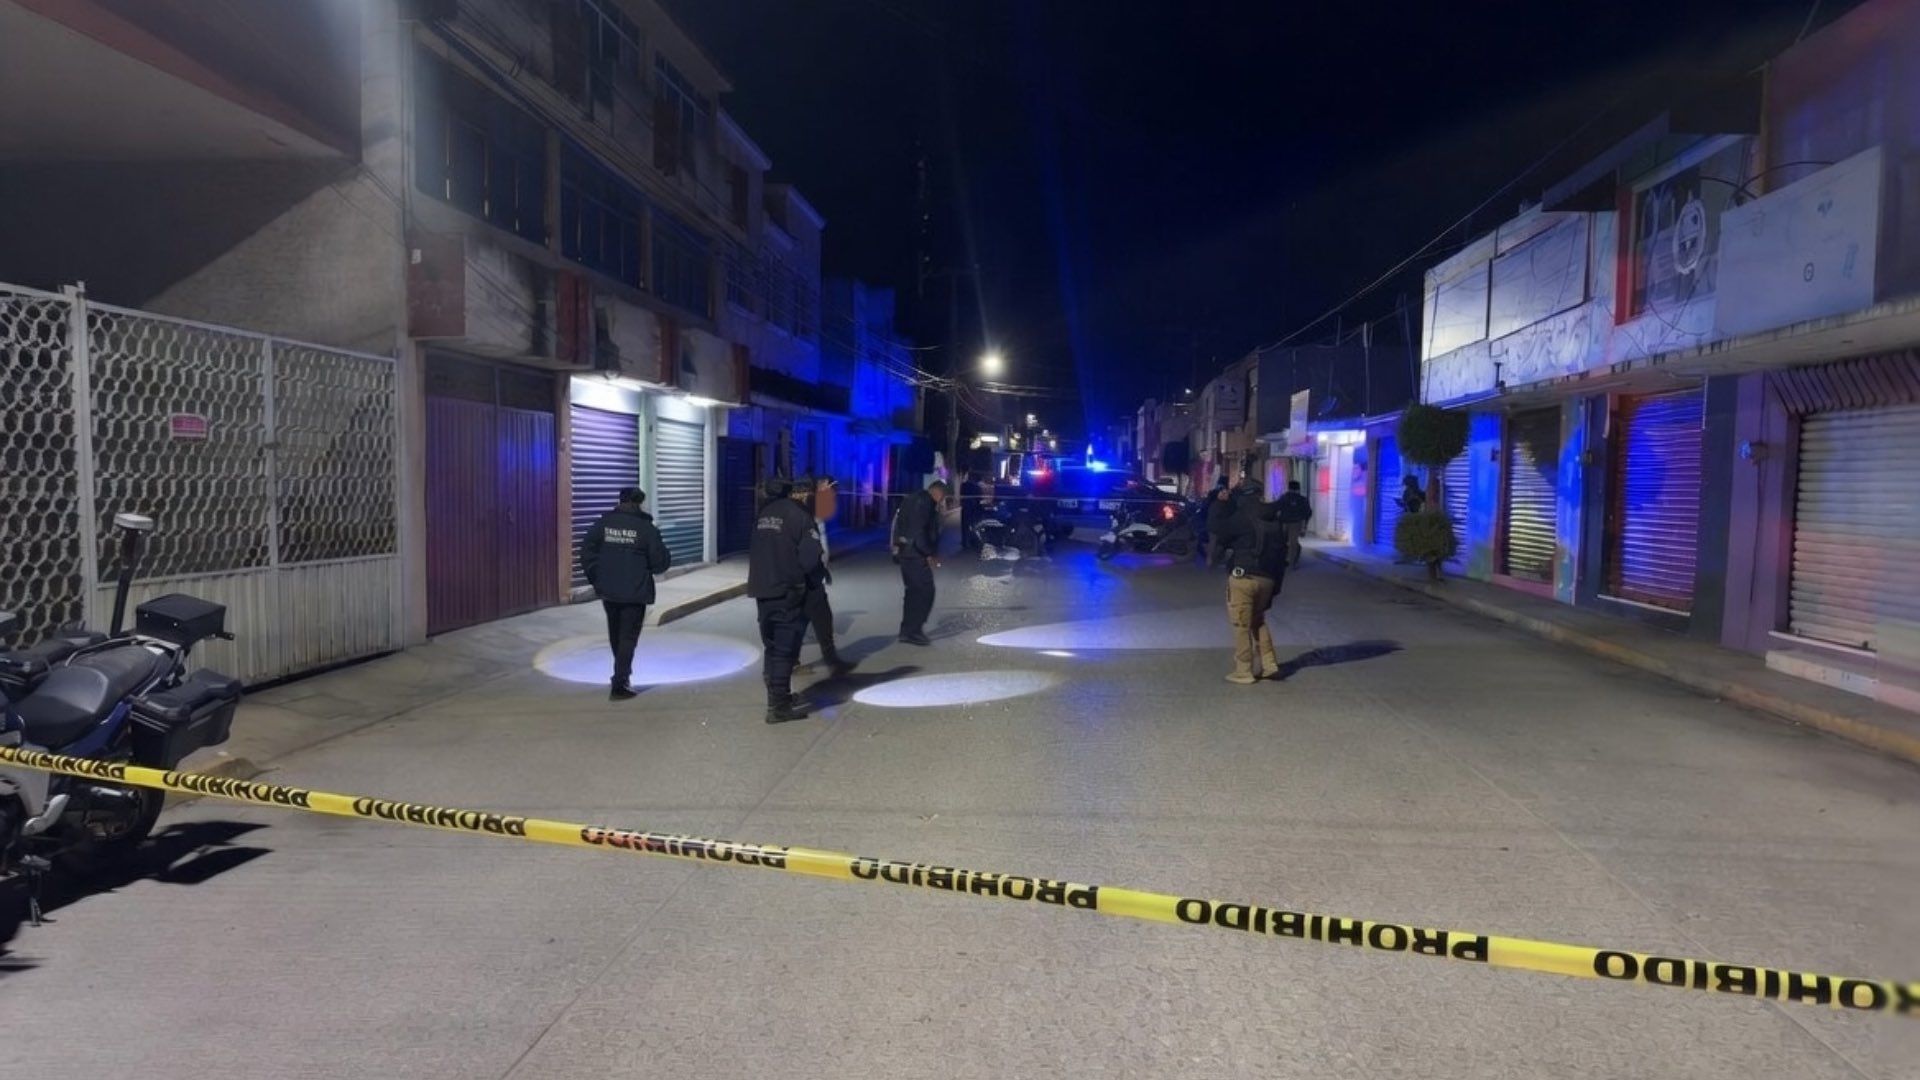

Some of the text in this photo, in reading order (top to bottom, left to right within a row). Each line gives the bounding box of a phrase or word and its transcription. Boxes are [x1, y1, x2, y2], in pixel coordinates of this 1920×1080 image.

[162, 771, 310, 807] PROHIBIDO
[352, 797, 527, 836] PROHIBIDO
[580, 826, 789, 869] PROHIBIDO
[849, 856, 1099, 910] PROHIBIDO
[1175, 897, 1489, 963] PROHIBIDO
